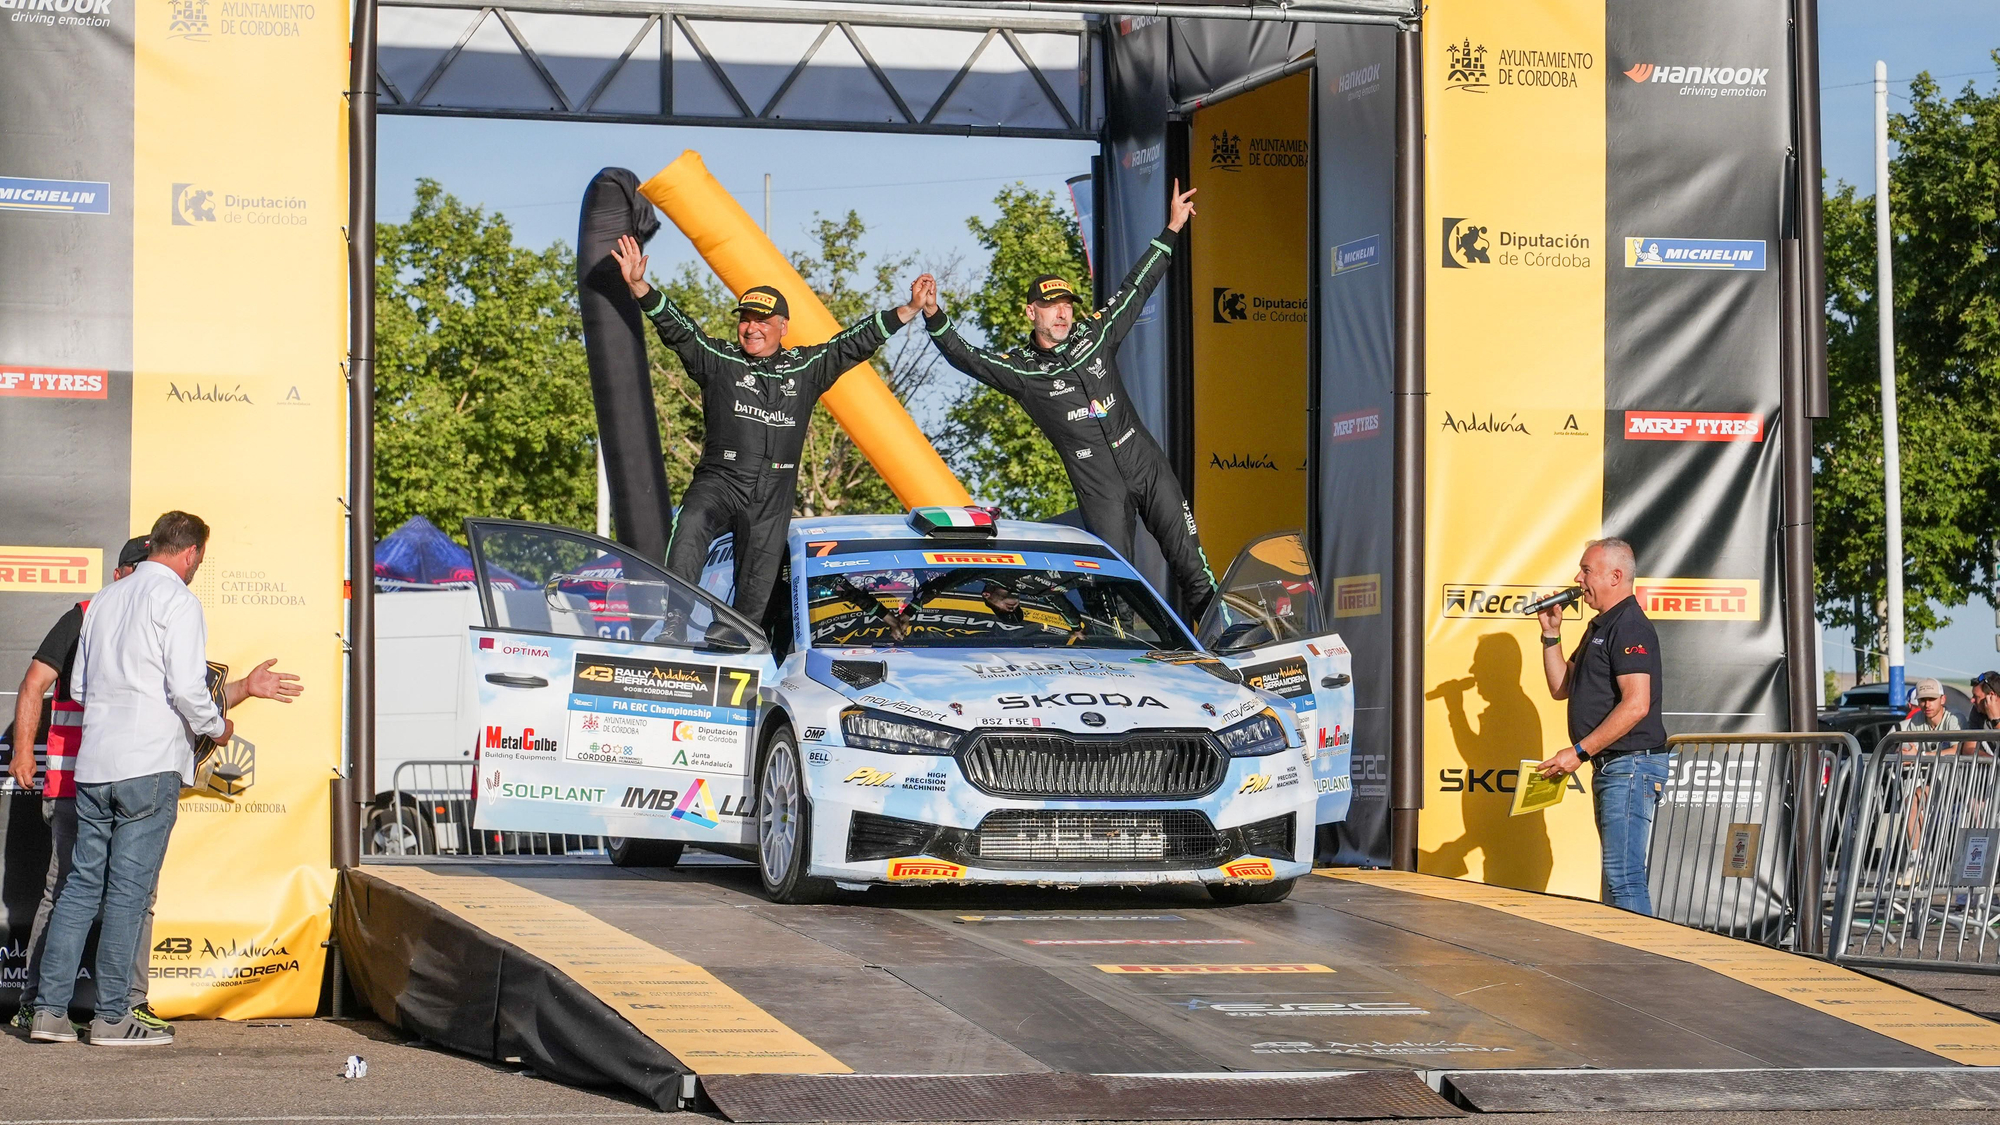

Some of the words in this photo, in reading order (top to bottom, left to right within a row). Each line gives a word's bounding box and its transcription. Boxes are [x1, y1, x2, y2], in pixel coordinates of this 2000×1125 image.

[221, 2, 315, 20] AYUNTAMIENTO
[11, 11, 55, 26] driving
[58, 16, 110, 28] emotion
[221, 21, 236, 34] DE
[1498, 49, 1593, 70] AYUNTAMIENTO
[1499, 69, 1514, 85] DE
[1680, 85, 1717, 98] driving
[1720, 87, 1767, 98] emotion
[1250, 139, 1308, 153] AYUNTAMIEN
[1249, 153, 1261, 166] DE
[225, 194, 306, 211] Diputación
[224, 211, 240, 224] de
[247, 211, 307, 226] Córdoba
[1500, 231, 1590, 252] Diputación
[1344, 245, 1375, 264] MICHELIN
[1498, 252, 1517, 266] de
[1524, 251, 1591, 268] Córdoba
[1665, 248, 1754, 261] MICHELIN
[1253, 297, 1308, 310] Diputació
[1252, 311, 1266, 322] de
[30, 374, 102, 392] TYRES
[166, 381, 255, 405] Andalucía
[1333, 419, 1355, 437] MRF
[1356, 414, 1379, 433] TYRES
[1441, 410, 1532, 436] Andalucía
[1629, 417, 1692, 434] MRF
[1696, 419, 1759, 436] TYRES
[1210, 452, 1279, 471] Andalucía
[808, 541, 838, 557] 7
[934, 554, 1015, 564] PIRELLI
[221, 570, 266, 579] CABILDO
[221, 581, 287, 593] CATEDRAL
[221, 594, 239, 605] DE
[242, 591, 306, 606] CÓRDOBA
[1338, 582, 1377, 610] PIRELLI
[503, 646, 550, 658] OPTIMA
[579, 665, 614, 683] 43
[615, 668, 652, 679] RALLY
[650, 666, 703, 684] Andalucía
[963, 661, 1064, 674] Verde
[614, 676, 656, 688] SIERRA
[656, 681, 708, 692] MORENA
[1262, 673, 1280, 683] RALLY
[1263, 679, 1283, 690] SIERRA
[1283, 675, 1308, 687] MORENA
[643, 687, 674, 697] CÓRDOBA
[729, 672, 751, 706] 7
[613, 701, 627, 710] FIA
[630, 702, 648, 712] ERC
[650, 704, 712, 719] Championship
[860, 695, 948, 721] movisport
[604, 716, 648, 727] AYUNTAMIENTO
[982, 717, 1003, 725] 8SZ
[1009, 717, 1030, 725] F5E
[603, 725, 611, 733] DE
[612, 725, 640, 735] CÓRDOBA
[698, 726, 738, 736] Diputación
[804, 728, 826, 739] OMP
[485, 726, 557, 752] MetalColbe
[708, 735, 738, 744] Córdoba
[485, 751, 514, 760] Building
[516, 753, 557, 761] Equipments
[577, 752, 617, 763] CÓRDOBA
[809, 752, 829, 762] BELL
[700, 759, 733, 769] Andalucía
[843, 766, 896, 786] PM
[905, 777, 946, 785] PRECISION
[1277, 773, 1298, 782] PRECISION
[902, 784, 946, 792] MACHINING
[1276, 779, 1299, 789] MACHINING
[1314, 776, 1349, 793] LPLANT
[502, 783, 606, 803] SOLPLANT
[179, 802, 231, 813] NIVERSIDAD
[245, 800, 287, 813] CÓRDOBA
[892, 862, 960, 877] PIRELLI
[1226, 861, 1272, 878] PIRELLI
[153, 937, 192, 954] 43
[200, 937, 291, 959] Andalucía
[148, 967, 217, 979] SIERRA
[222, 960, 299, 979] MORENA
[1119, 964, 1310, 972] PIRELLI
